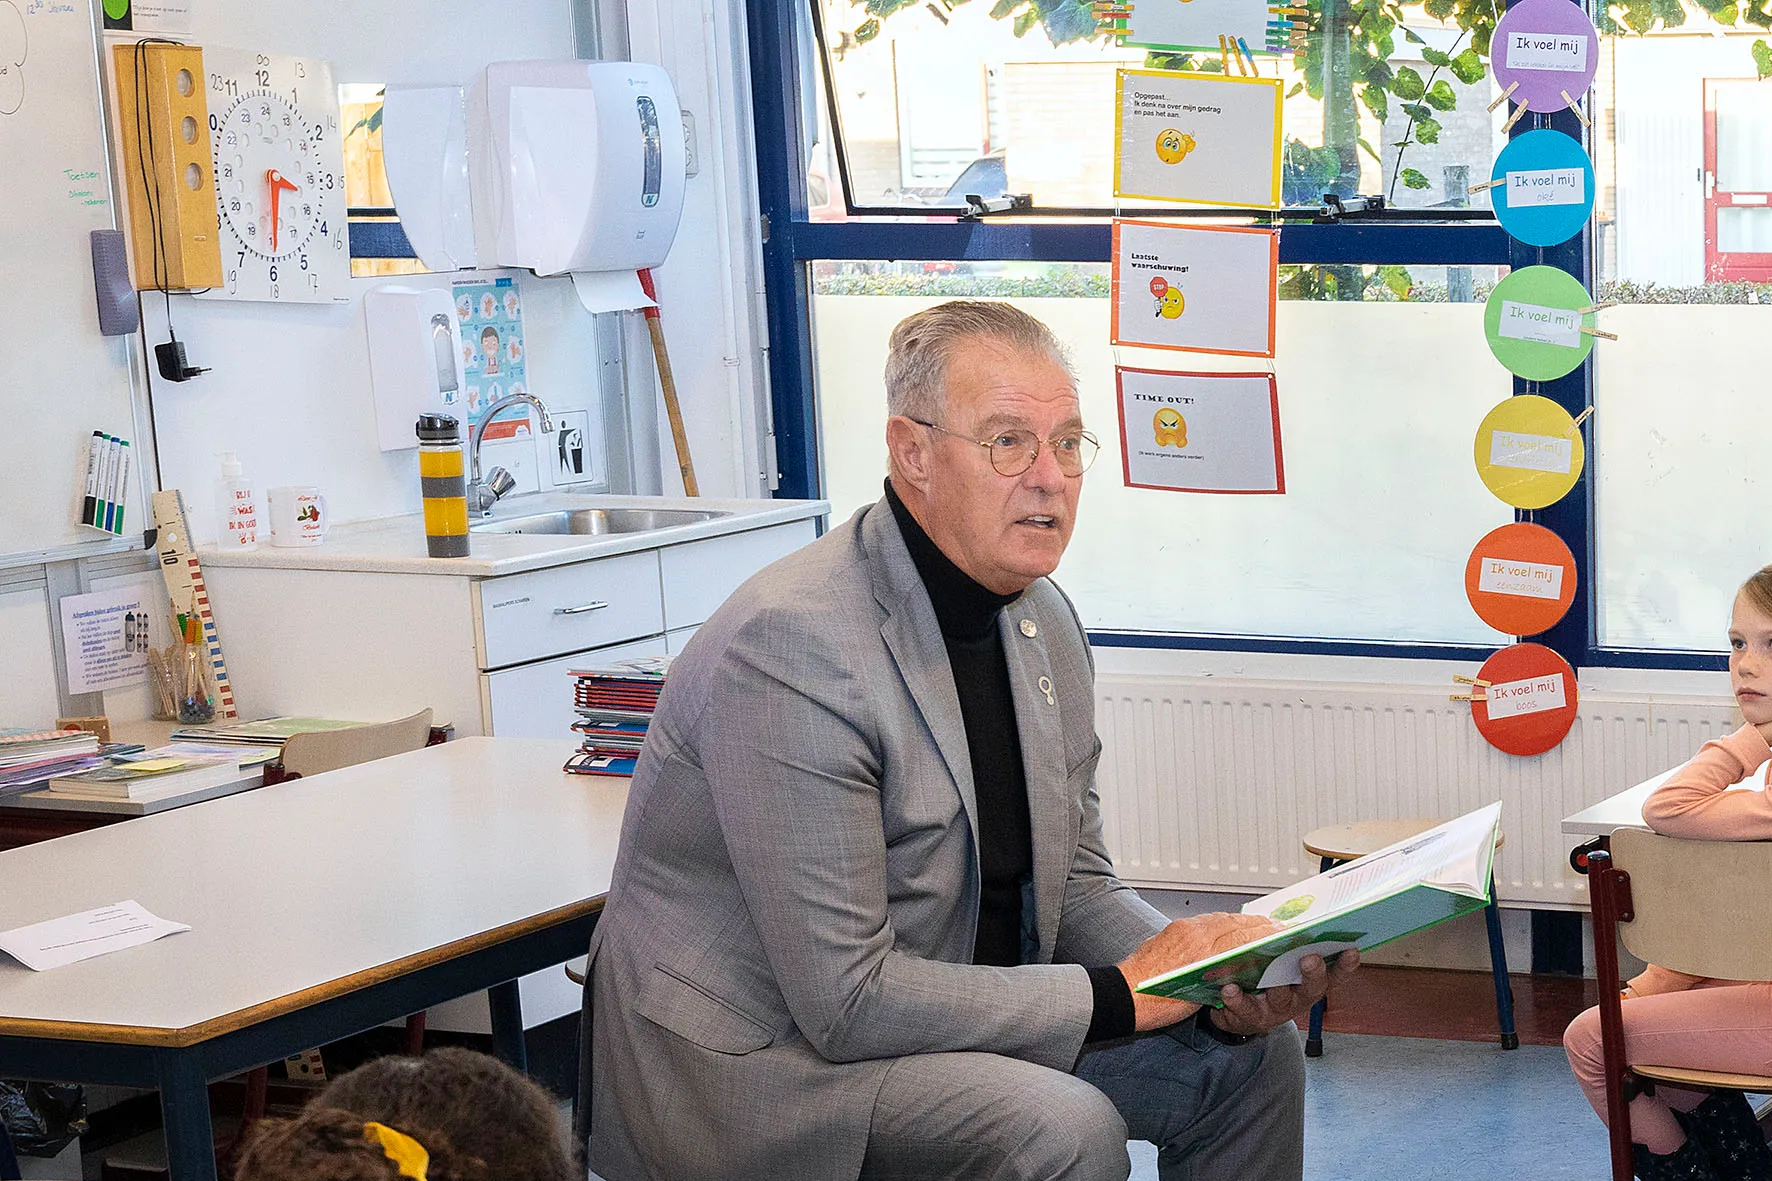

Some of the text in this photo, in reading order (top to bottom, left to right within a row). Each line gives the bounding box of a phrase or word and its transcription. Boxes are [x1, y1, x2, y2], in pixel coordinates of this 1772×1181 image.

[1516, 37, 1578, 55] Ik voel mij
[211, 73, 224, 92] 23
[255, 69, 270, 87] 12
[225, 80, 238, 96] 11
[292, 87, 298, 103] 1
[1198, 105, 1222, 114] gedrag
[315, 124, 323, 141] 2
[326, 174, 334, 190] 3
[1515, 173, 1576, 188] Ik voel mij
[231, 201, 241, 212] 20
[320, 220, 328, 237] 4
[237, 252, 245, 268] 7
[300, 254, 308, 271] 5
[1131, 253, 1159, 261] Laatste
[269, 265, 278, 282] 6
[1131, 262, 1189, 273] waarschuwing!
[1510, 306, 1574, 330] Ik voel mij
[1134, 393, 1195, 405] TIME OUT!
[1501, 435, 1563, 457] Ik voel mij
[161, 549, 179, 566] 10
[1491, 563, 1553, 583] Ik voel mij
[1494, 679, 1556, 700] Ik voel mij
